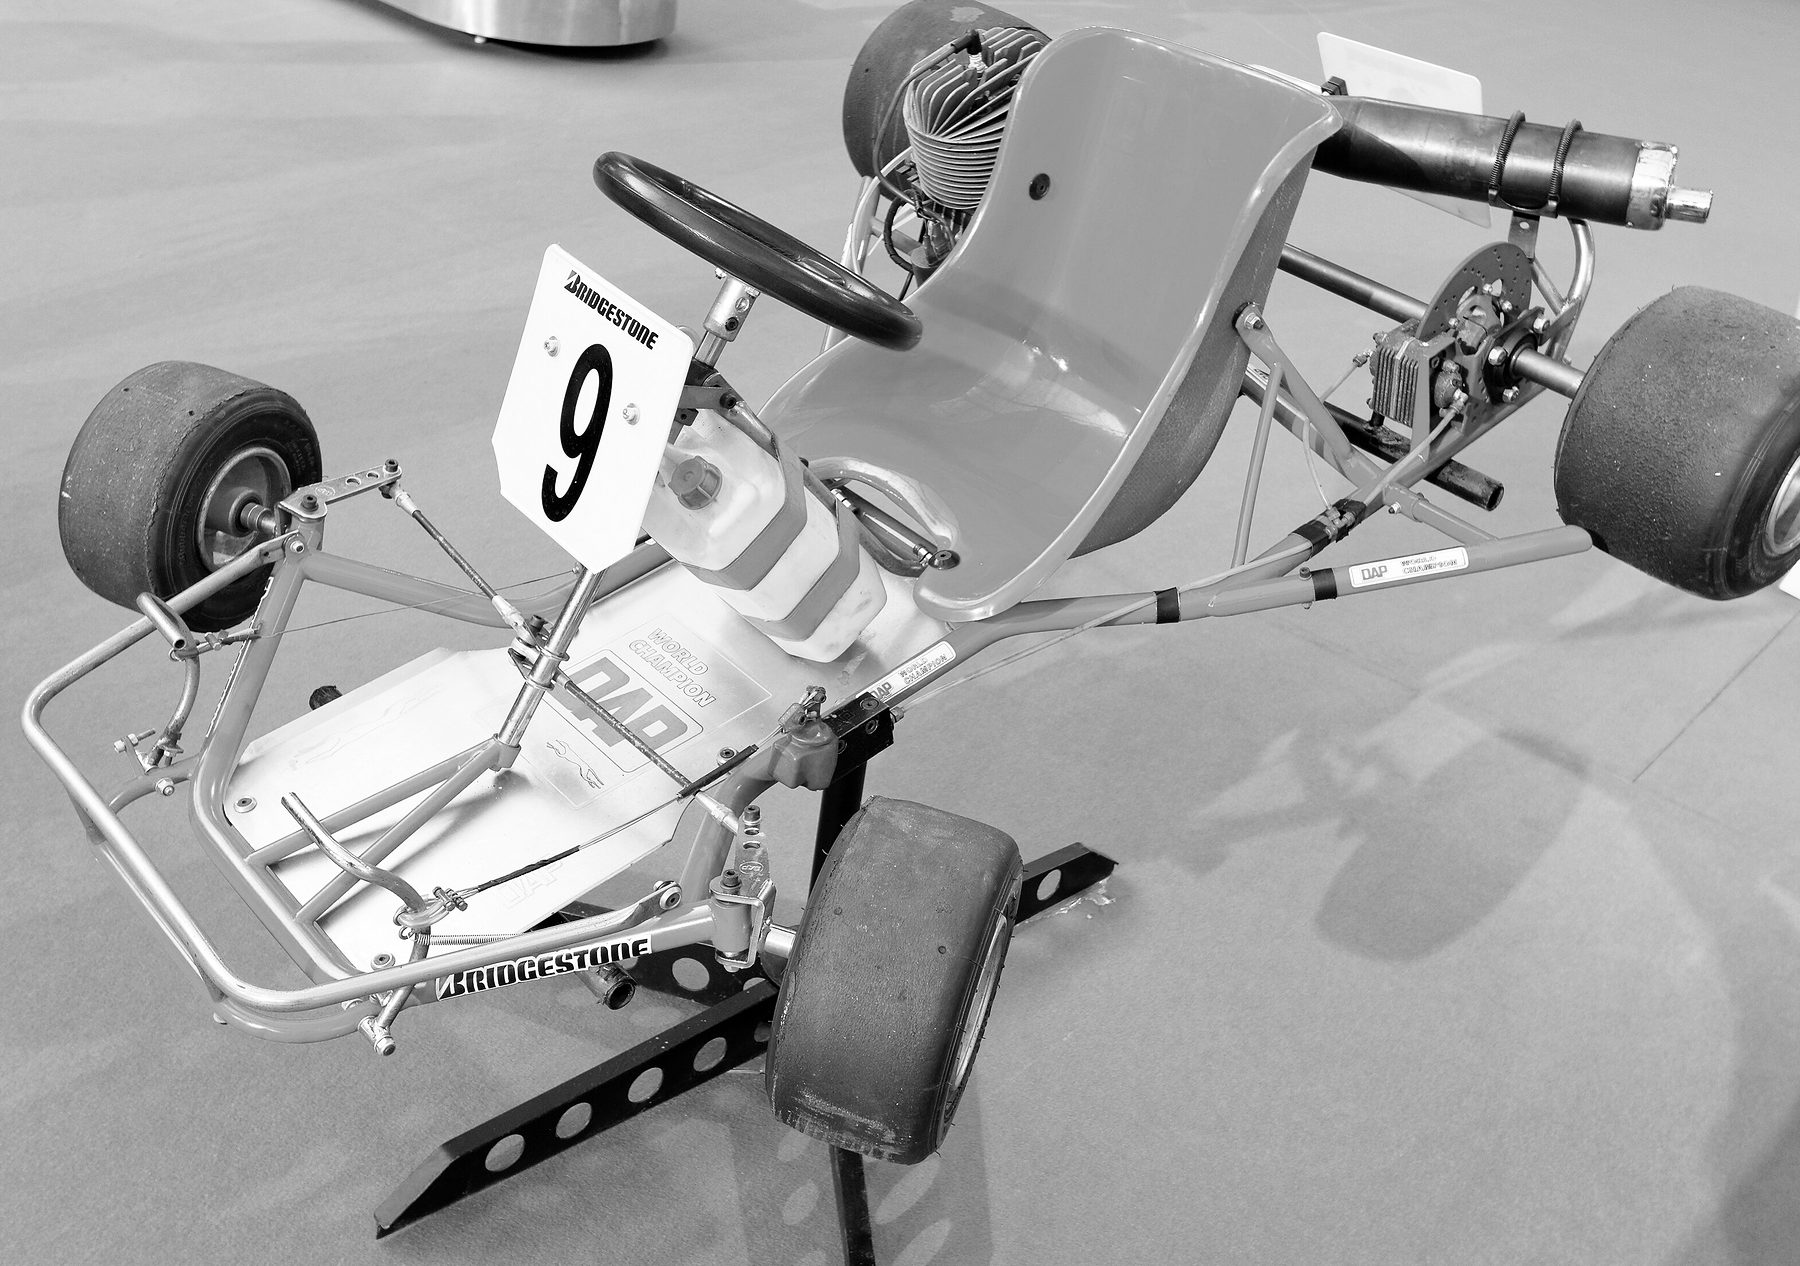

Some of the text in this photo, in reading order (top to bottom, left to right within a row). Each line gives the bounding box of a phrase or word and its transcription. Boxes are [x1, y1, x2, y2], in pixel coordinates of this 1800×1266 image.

[564, 270, 659, 350] BRIDGESTONE
[541, 343, 613, 523] 9
[1361, 565, 1388, 581] DAP
[629, 639, 717, 708] CHAMPION
[647, 629, 709, 676] WORLD
[548, 656, 688, 752] DAP
[436, 938, 648, 1000] BRIDGESTONE
